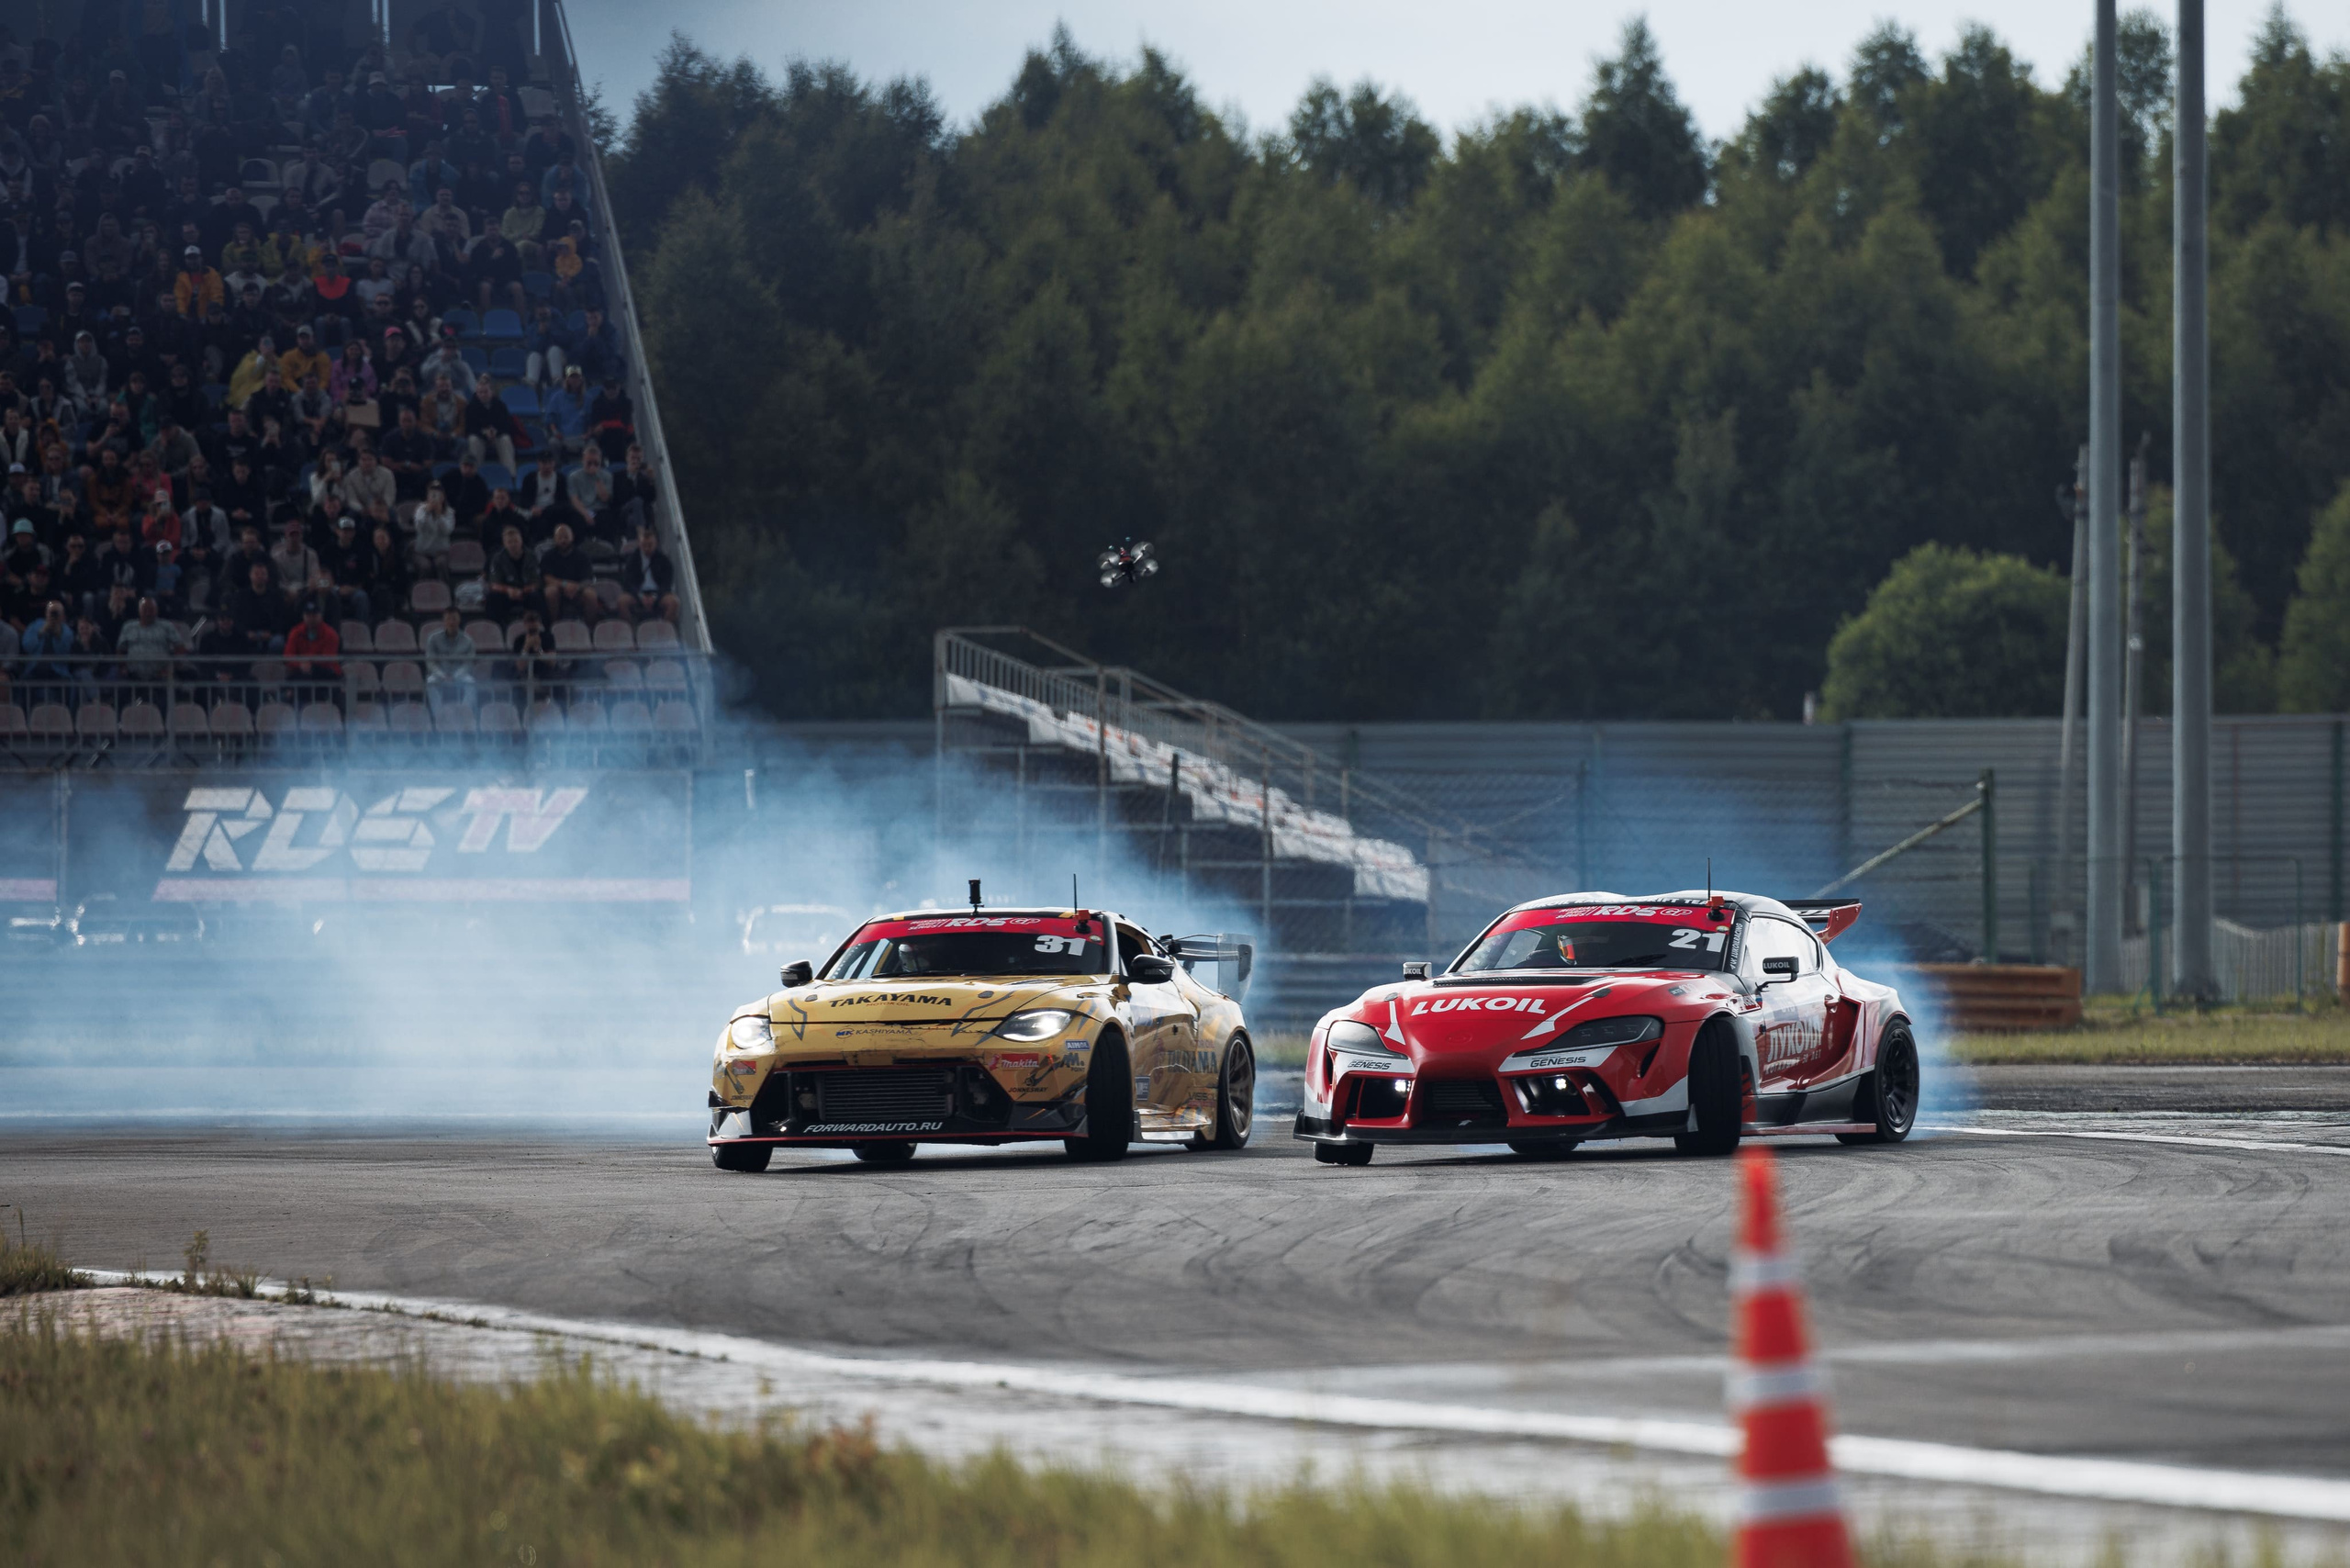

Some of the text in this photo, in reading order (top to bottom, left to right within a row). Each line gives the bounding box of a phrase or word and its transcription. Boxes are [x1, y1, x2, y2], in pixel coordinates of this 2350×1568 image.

[166, 787, 589, 871] RDS TV
[1593, 905, 1665, 917] RDS
[945, 917, 1013, 927] RDS
[1034, 935, 1086, 957] 31
[1668, 928, 1726, 953] 21
[1762, 961, 1790, 969] LUKOIL
[829, 993, 952, 1008] TAKAYAMA
[1411, 997, 1547, 1016] LUKOIL
[1347, 1060, 1392, 1070] GENESIS
[1529, 1057, 1587, 1068] GENESIS
[803, 1122, 943, 1133] FORWARDAUTO.RU
